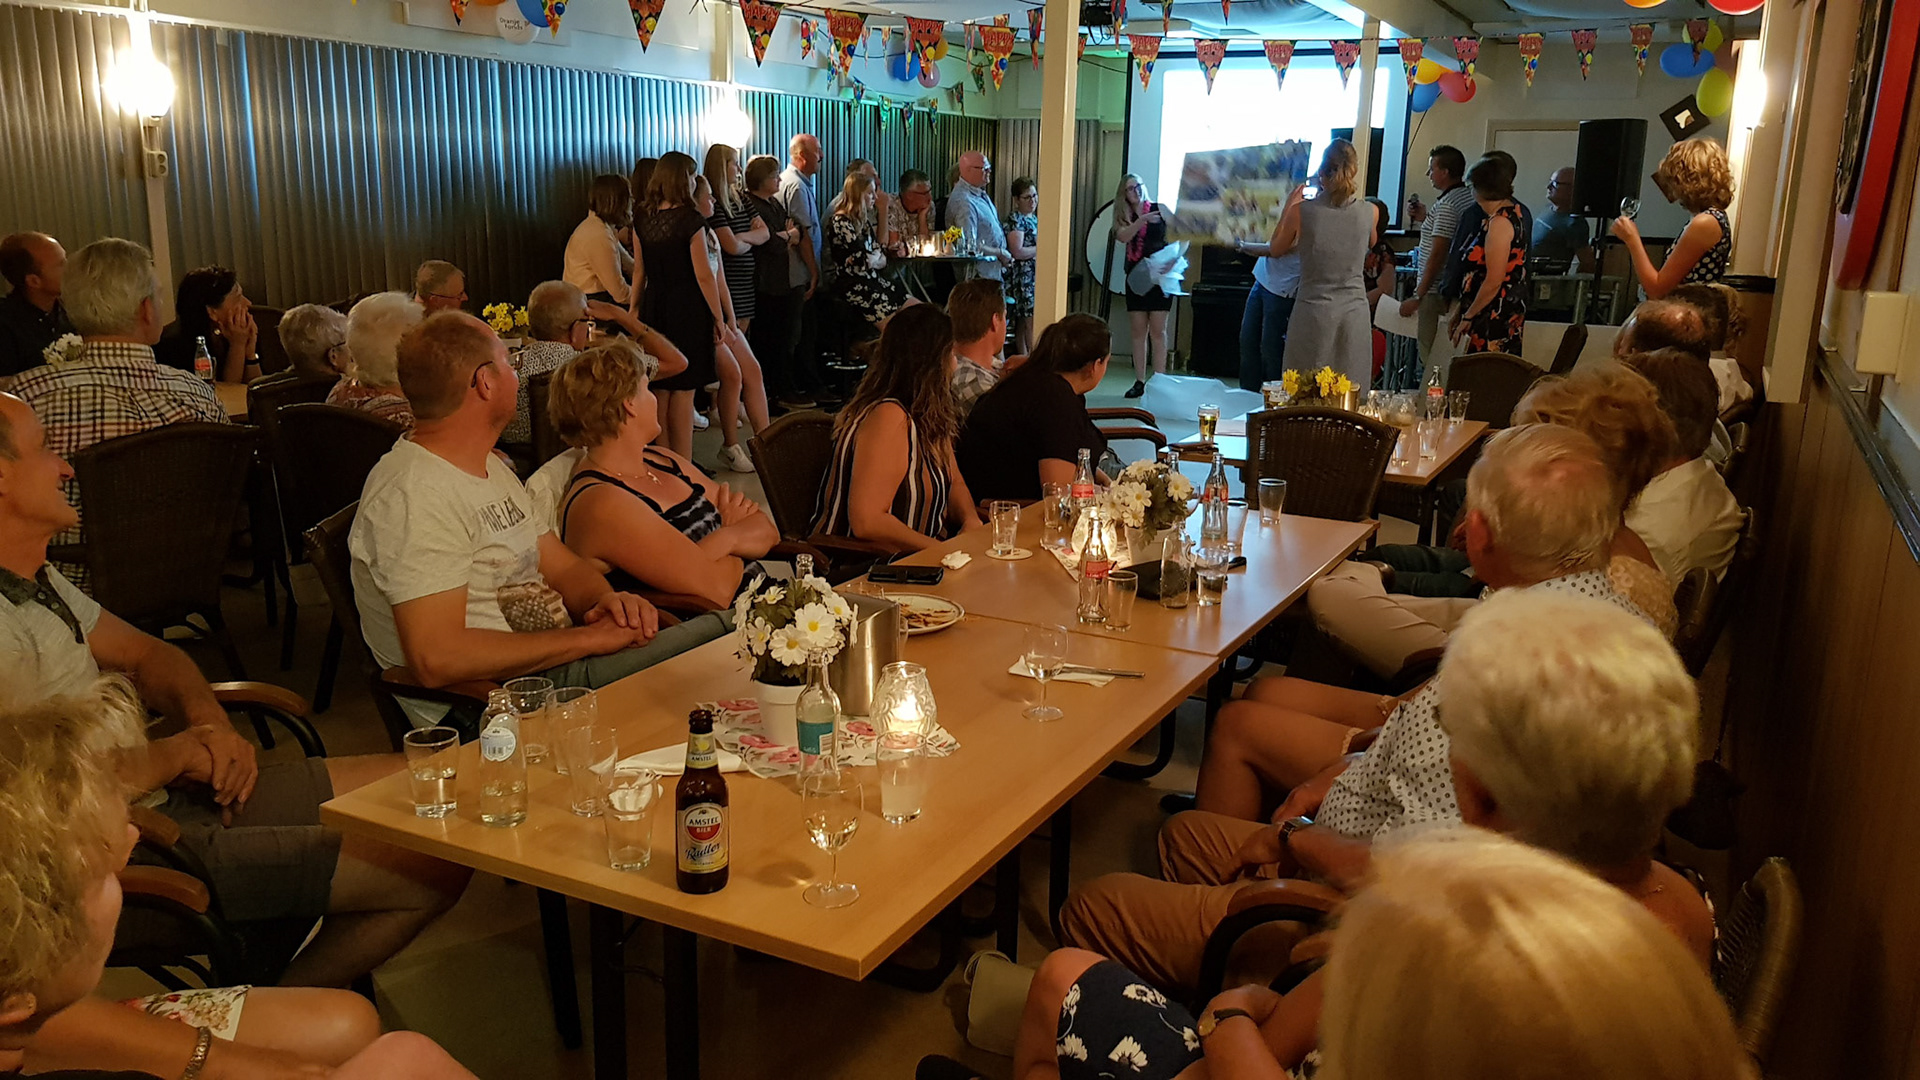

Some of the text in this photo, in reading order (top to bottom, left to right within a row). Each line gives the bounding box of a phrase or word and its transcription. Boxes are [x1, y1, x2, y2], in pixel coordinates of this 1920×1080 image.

[743, 3, 780, 21] HAPPY
[689, 816, 719, 826] AMSTEL
[696, 826, 712, 834] BIER
[684, 842, 721, 861] Radler
